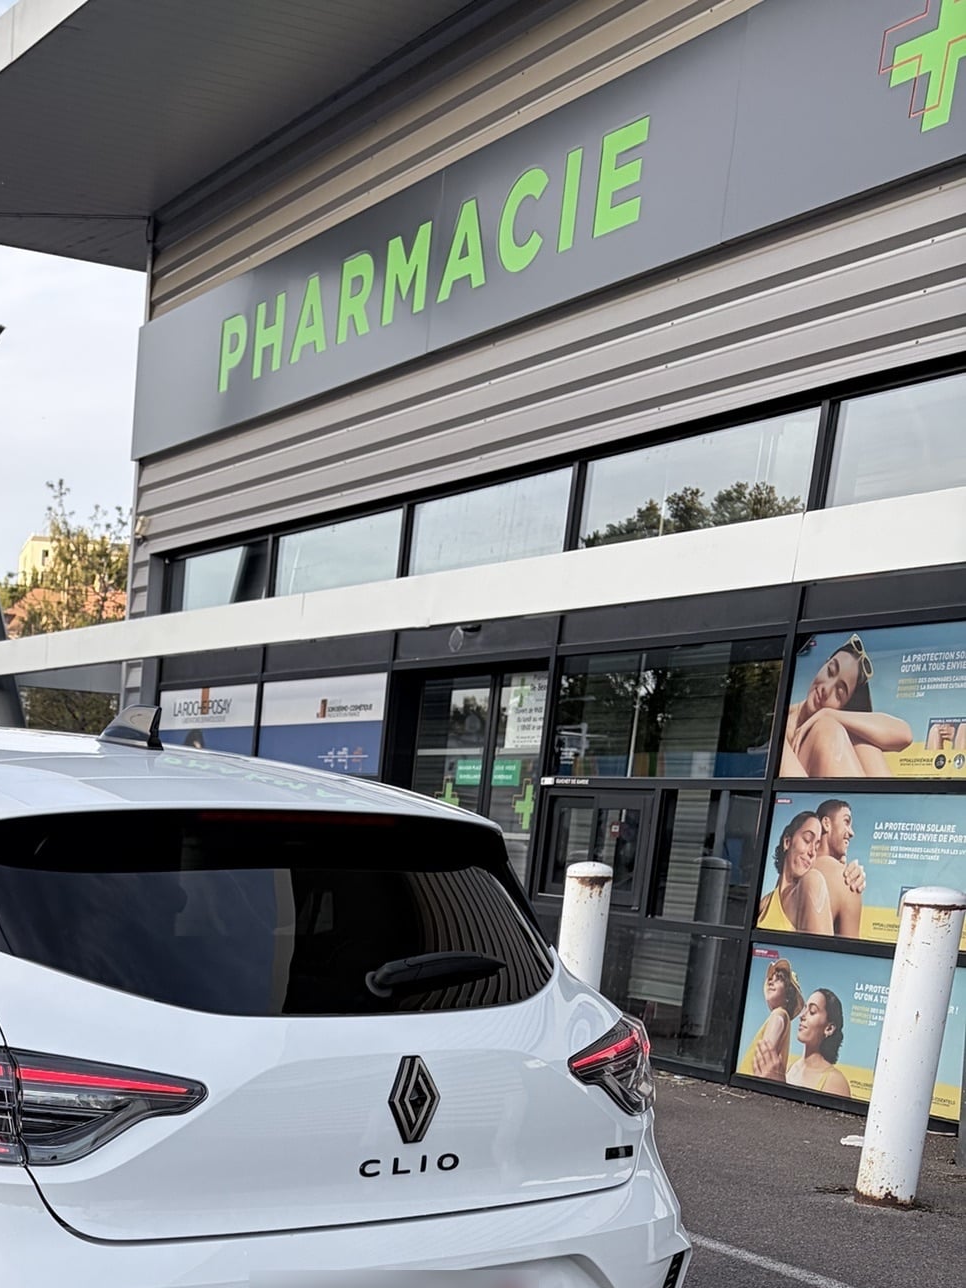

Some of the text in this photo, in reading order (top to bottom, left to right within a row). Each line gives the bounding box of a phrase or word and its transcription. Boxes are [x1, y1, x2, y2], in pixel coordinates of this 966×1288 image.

[218, 115, 651, 394] PHARMACIE
[902, 650, 966, 663] LA PROTECTION SO
[900, 661, 966, 672] QU'ON A TOUS ENVIE
[874, 822, 956, 833] LA PROTECTION SOLAIRE
[873, 832, 893, 840] QU'ON
[893, 832, 899, 840] A
[900, 833, 917, 841] TOUS
[917, 833, 937, 842] ENVIE
[938, 834, 948, 843] DE
[855, 982, 864, 991] LA
[853, 992, 873, 1002] QU'ON
[358, 1152, 460, 1178] CLIO
